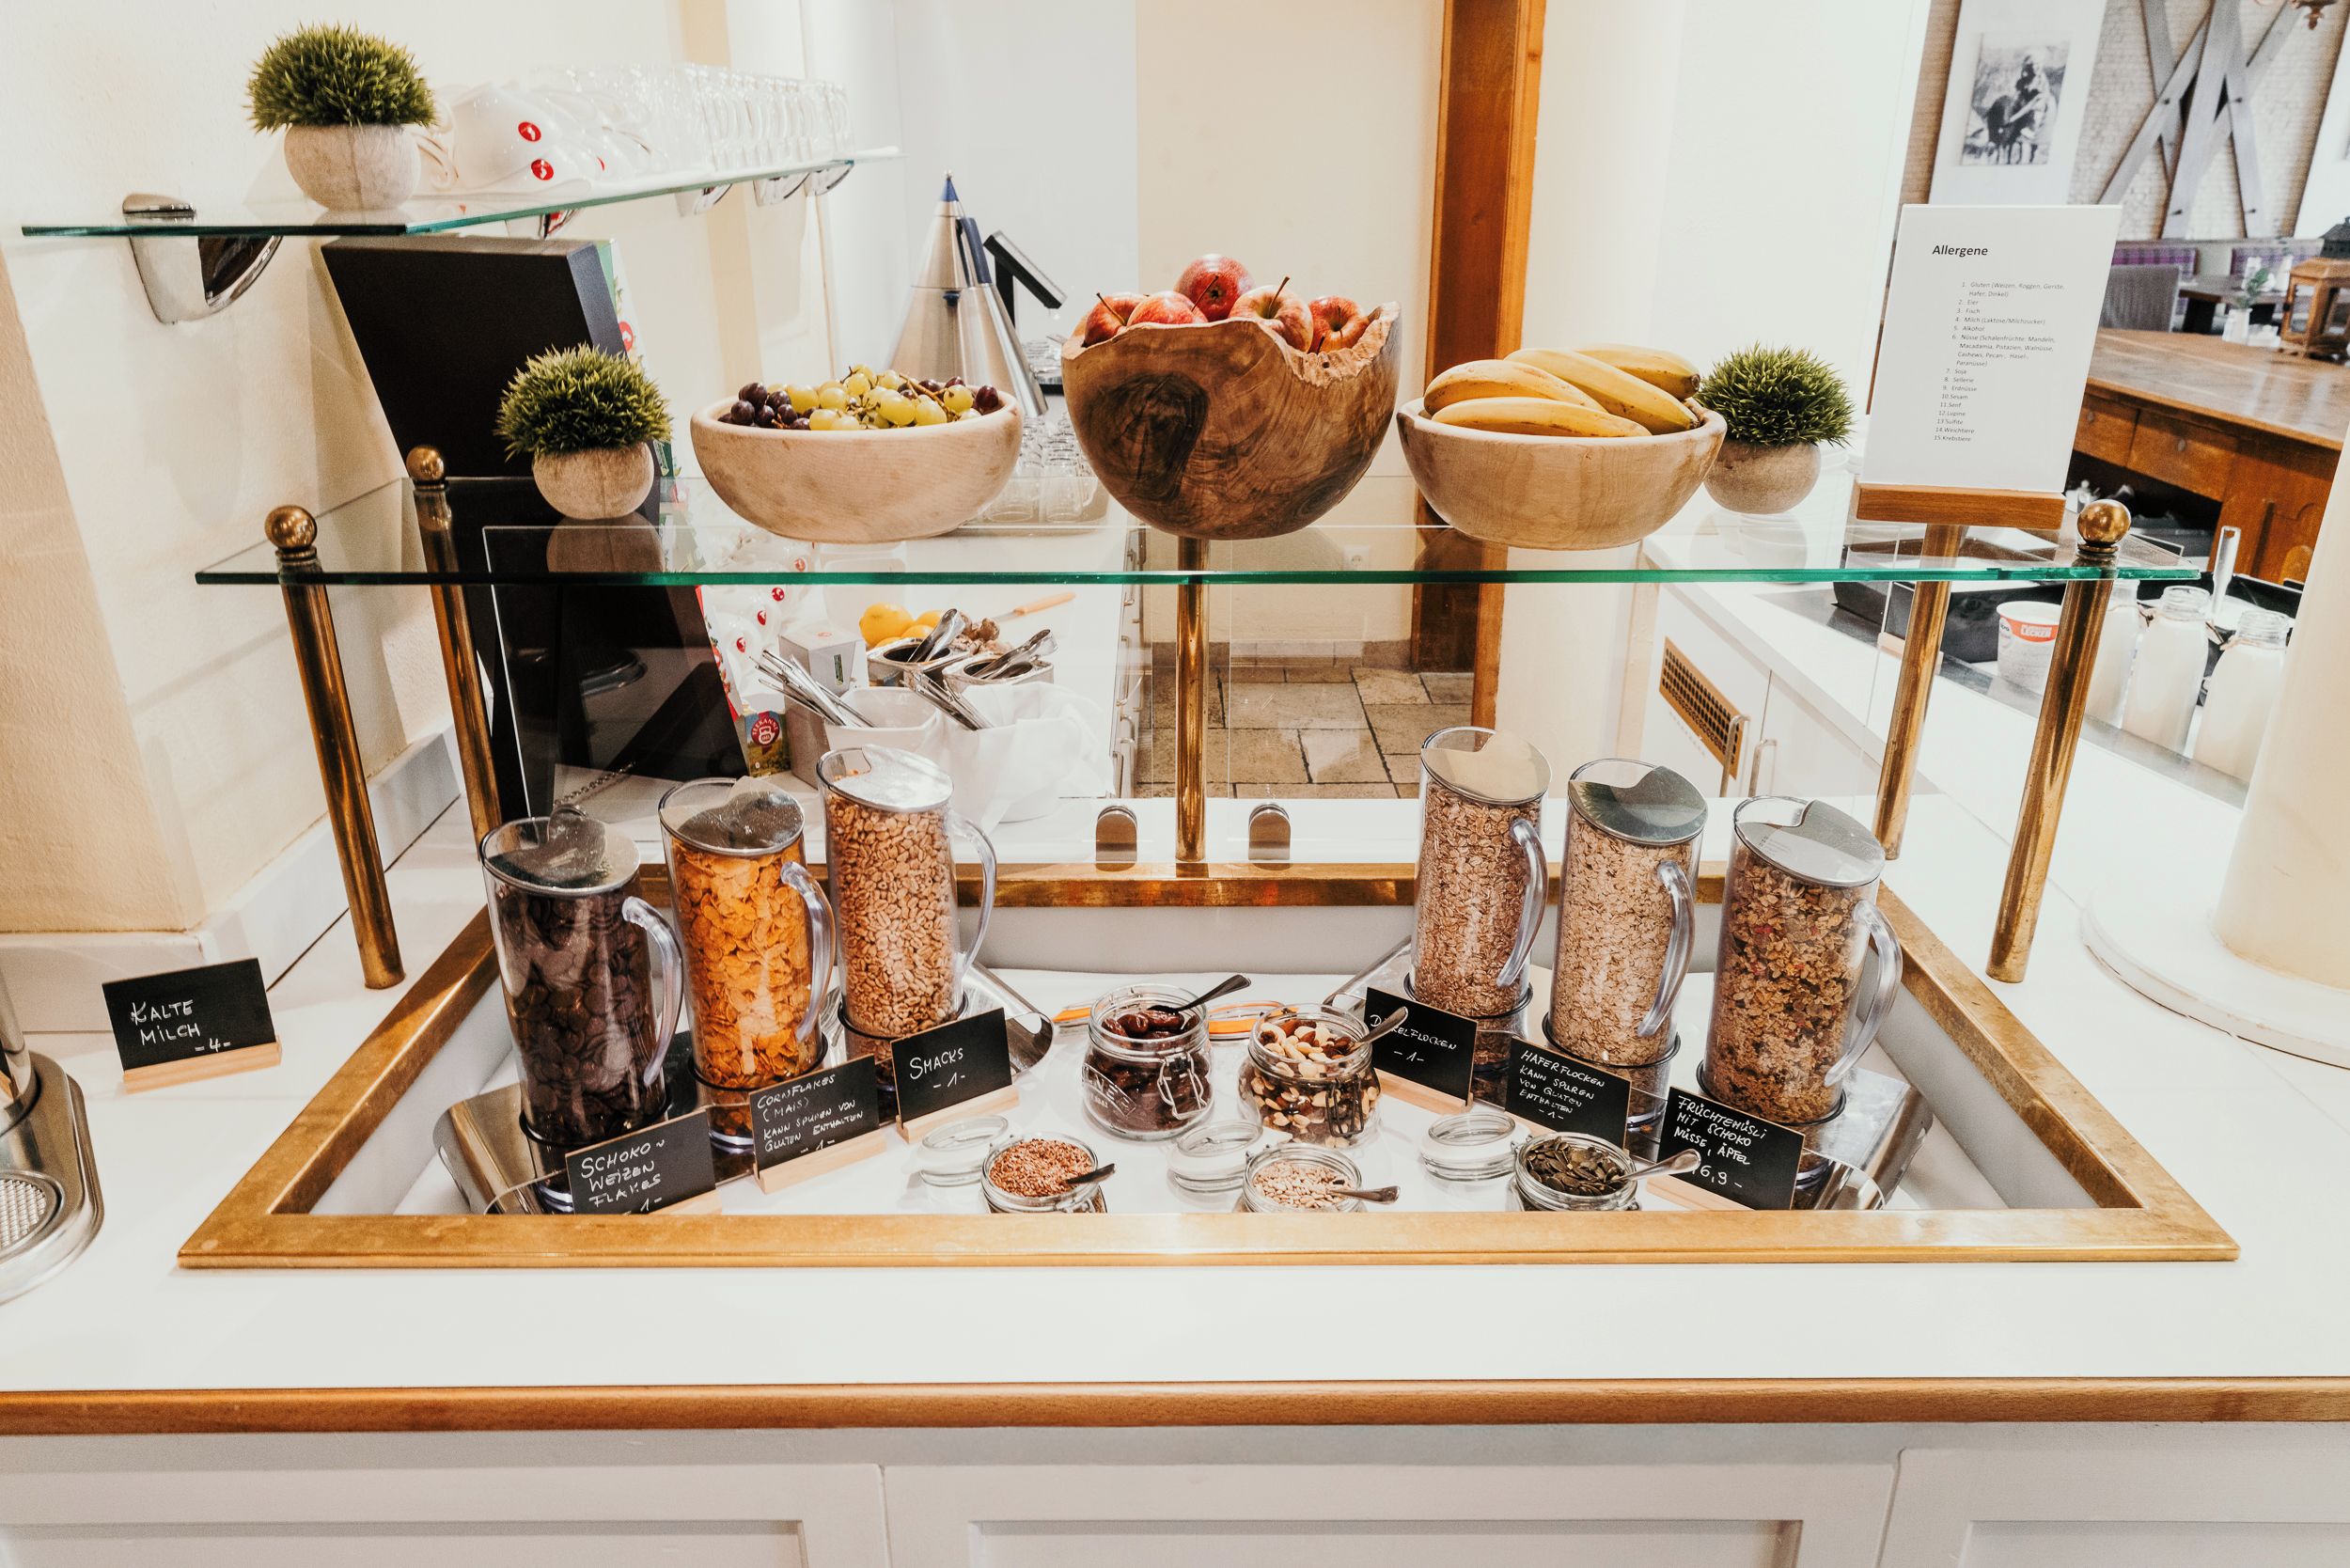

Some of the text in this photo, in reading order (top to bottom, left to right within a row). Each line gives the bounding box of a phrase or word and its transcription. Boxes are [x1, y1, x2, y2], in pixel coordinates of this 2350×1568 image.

[1932, 244, 1989, 258] Allergene
[131, 999, 194, 1026] KALTE
[909, 1047, 964, 1080] SMACKS
[757, 1074, 836, 1109] CORNFLAKES
[1519, 1064, 1595, 1100] KANN SPUREN
[1519, 1077, 1537, 1090] VON
[1519, 1089, 1574, 1114] ENTHALTEN
[763, 1122, 791, 1141] KANN
[838, 1099, 855, 1112] VON
[764, 1110, 864, 1152] GLUTEN ENTHALTEN
[1707, 1122, 1752, 1147] SCHOKO
[1716, 1142, 1751, 1166] ÄPFEL
[588, 1173, 662, 1208] FLAKES
